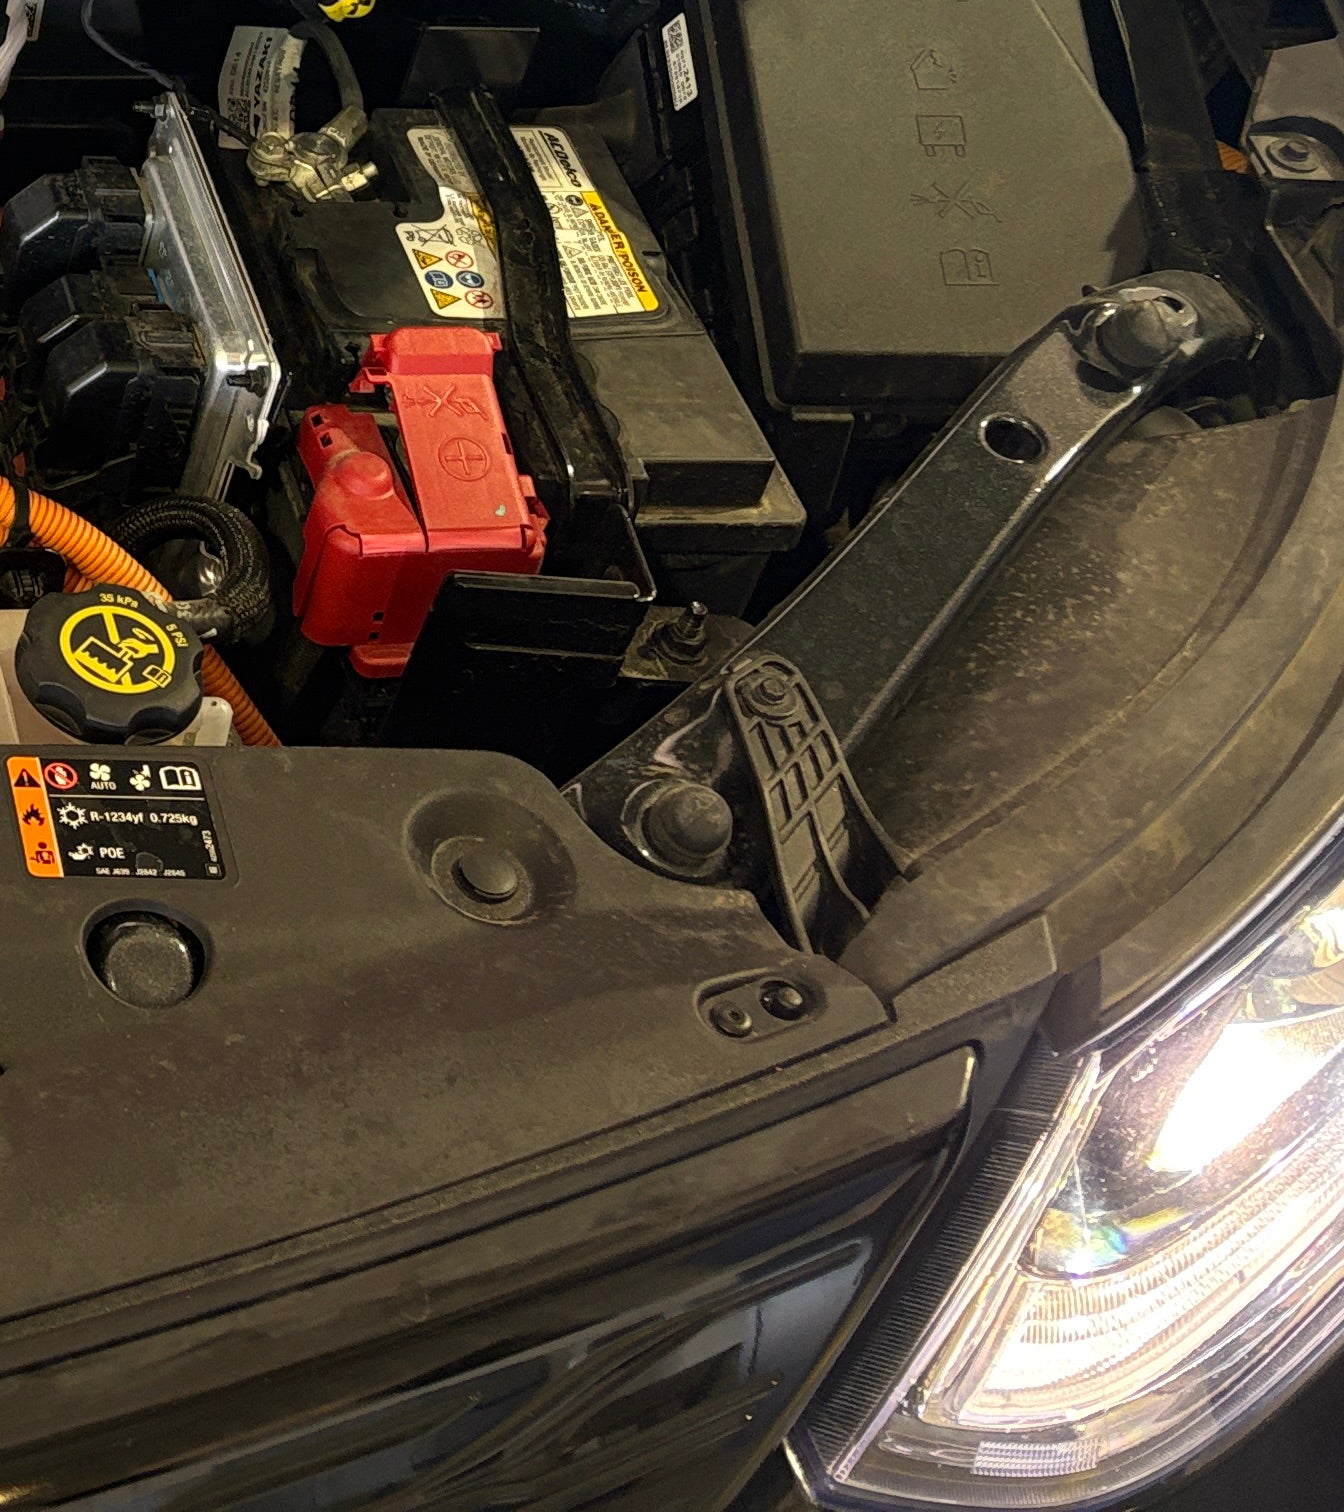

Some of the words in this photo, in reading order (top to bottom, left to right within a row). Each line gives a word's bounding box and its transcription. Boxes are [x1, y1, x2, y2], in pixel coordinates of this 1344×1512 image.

[254, 37, 272, 108] YAZAKI
[543, 132, 583, 189] ACDelco
[99, 593, 114, 603] 35
[116, 594, 139, 608] kPa
[165, 623, 178, 632] 5
[171, 631, 188, 647] PSI
[91, 782, 116, 790] AUTO
[90, 811, 143, 824] R-1234yf
[150, 813, 198, 826] 0.725kg
[99, 847, 125, 859] POE
[96, 867, 110, 875] SAE
